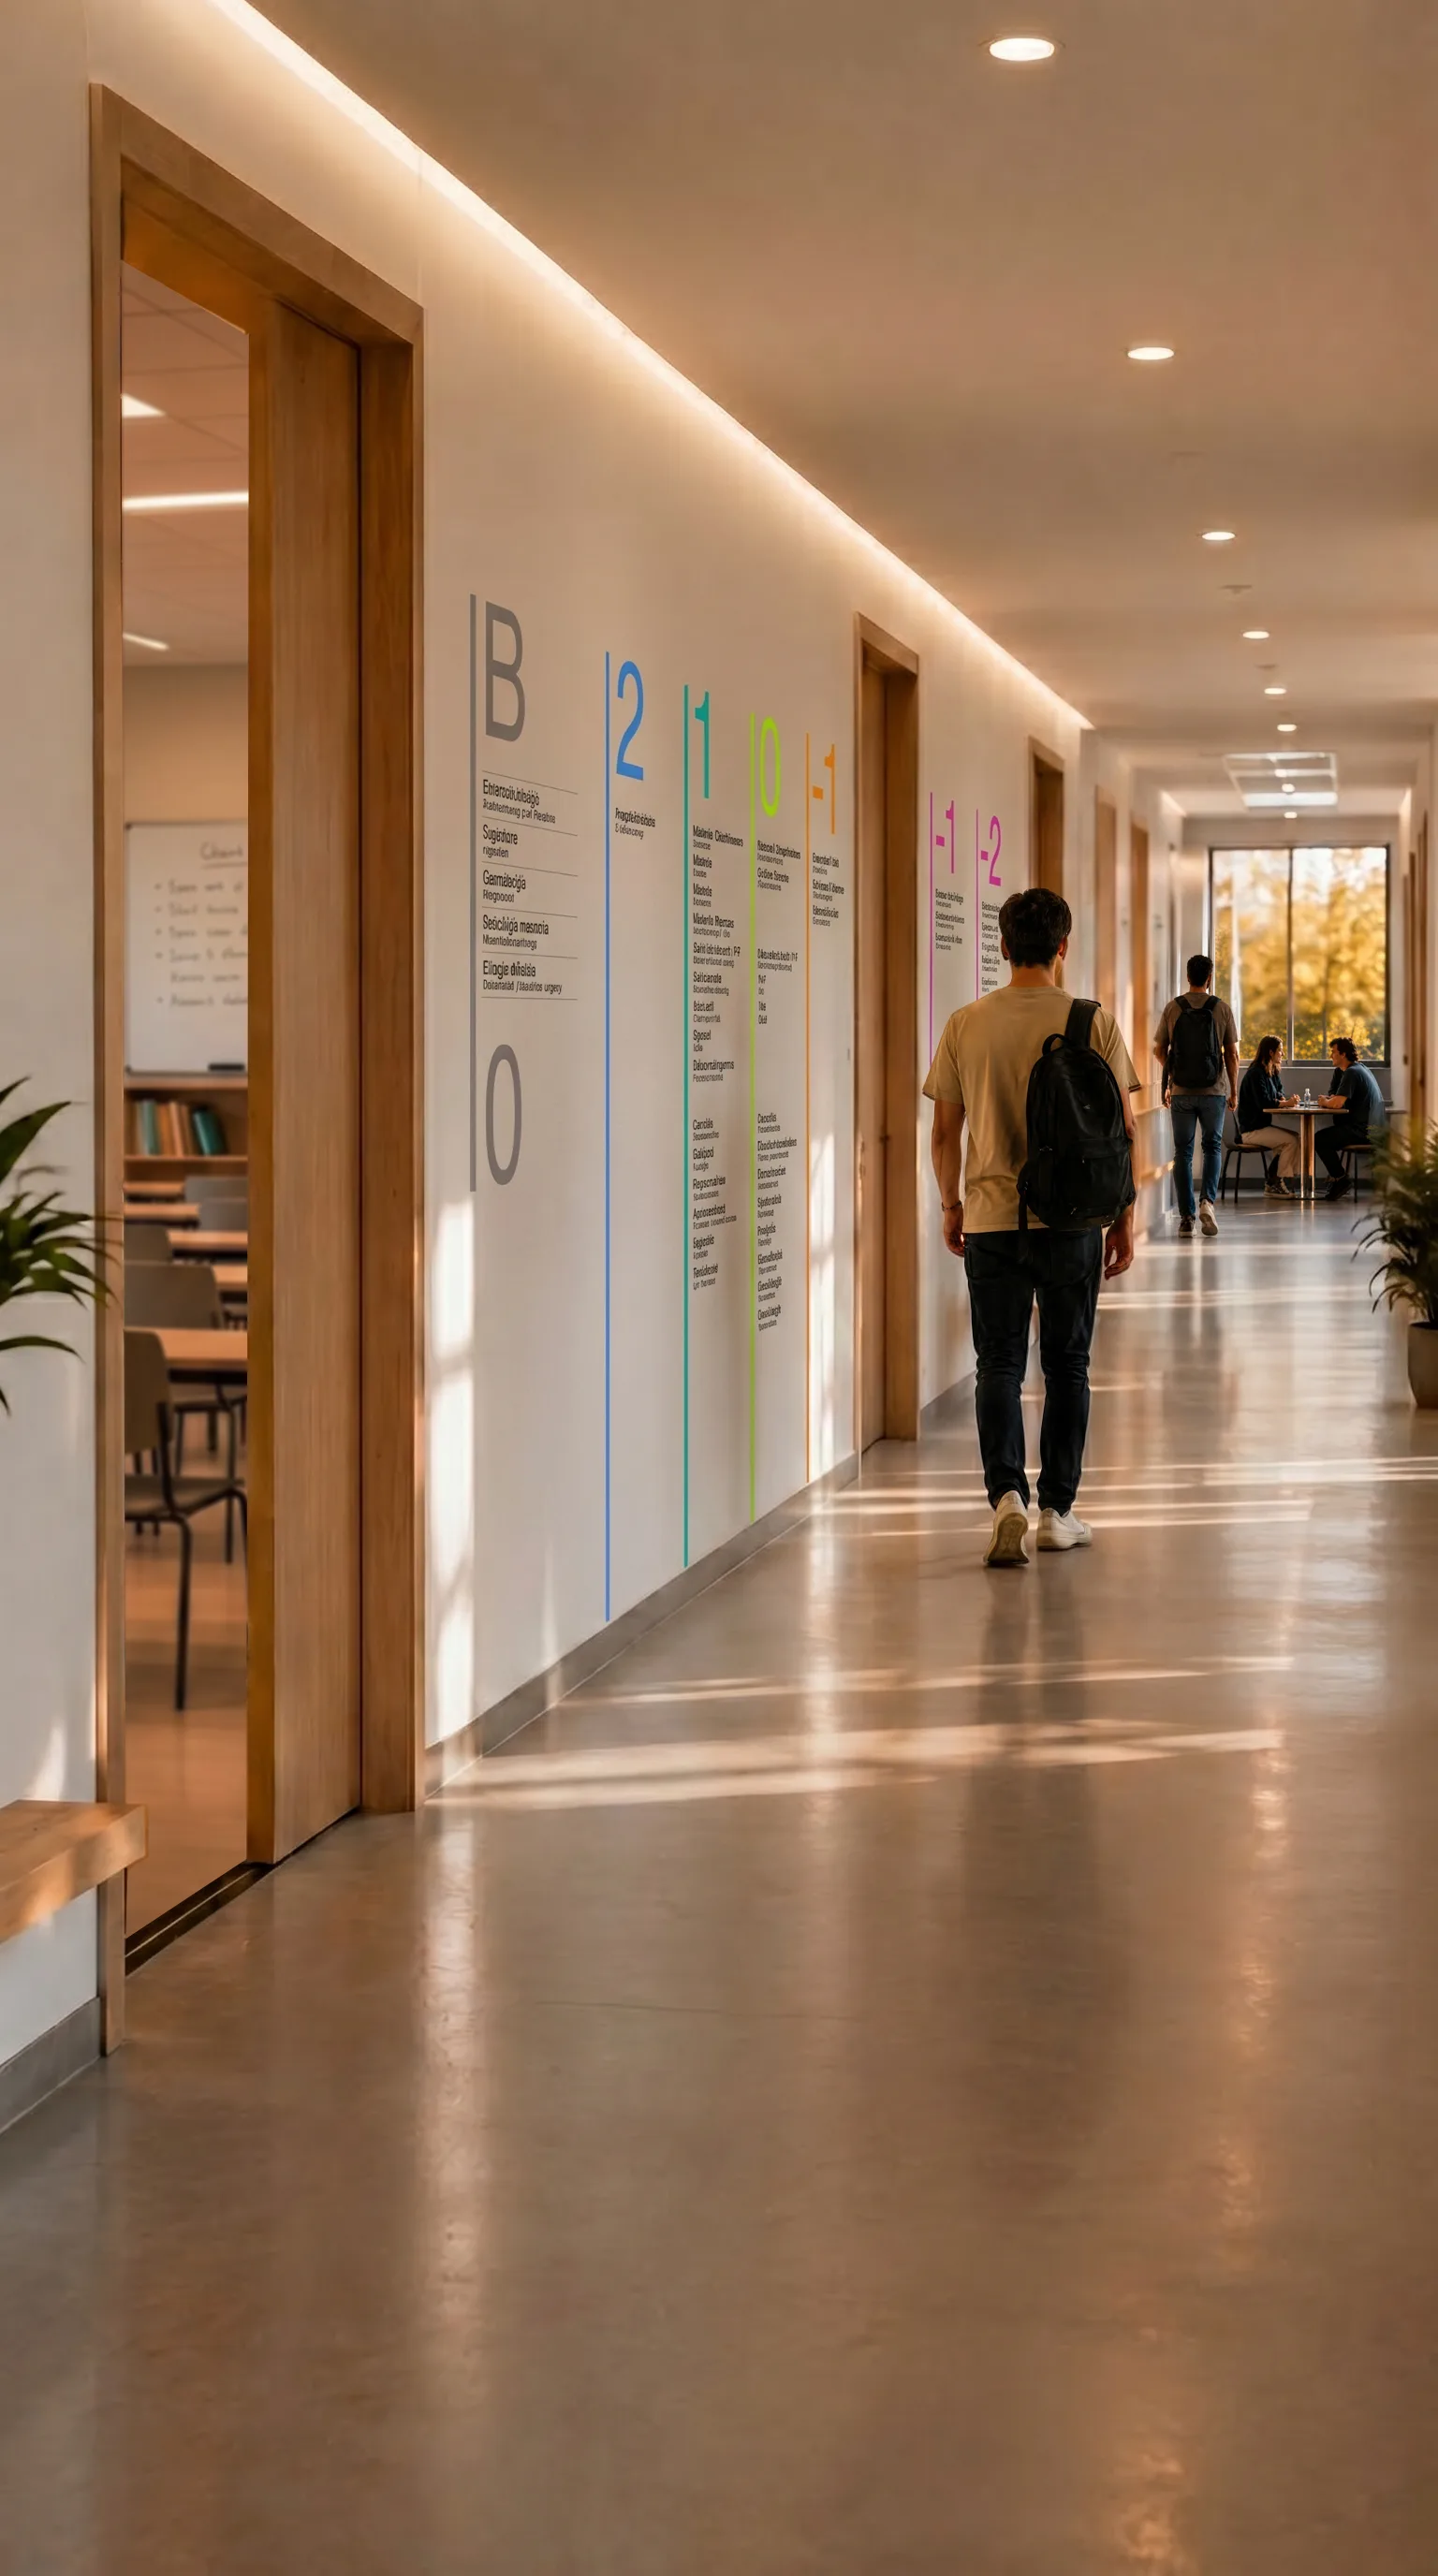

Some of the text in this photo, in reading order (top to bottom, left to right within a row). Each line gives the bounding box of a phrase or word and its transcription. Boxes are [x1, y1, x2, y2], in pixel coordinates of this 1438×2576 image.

[485, 600, 526, 742] B
[616, 660, 644, 781] 2
[694, 691, 710, 799] 1
[812, 743, 835, 835] -1
[935, 799, 955, 874] -1
[980, 815, 1002, 886] -2
